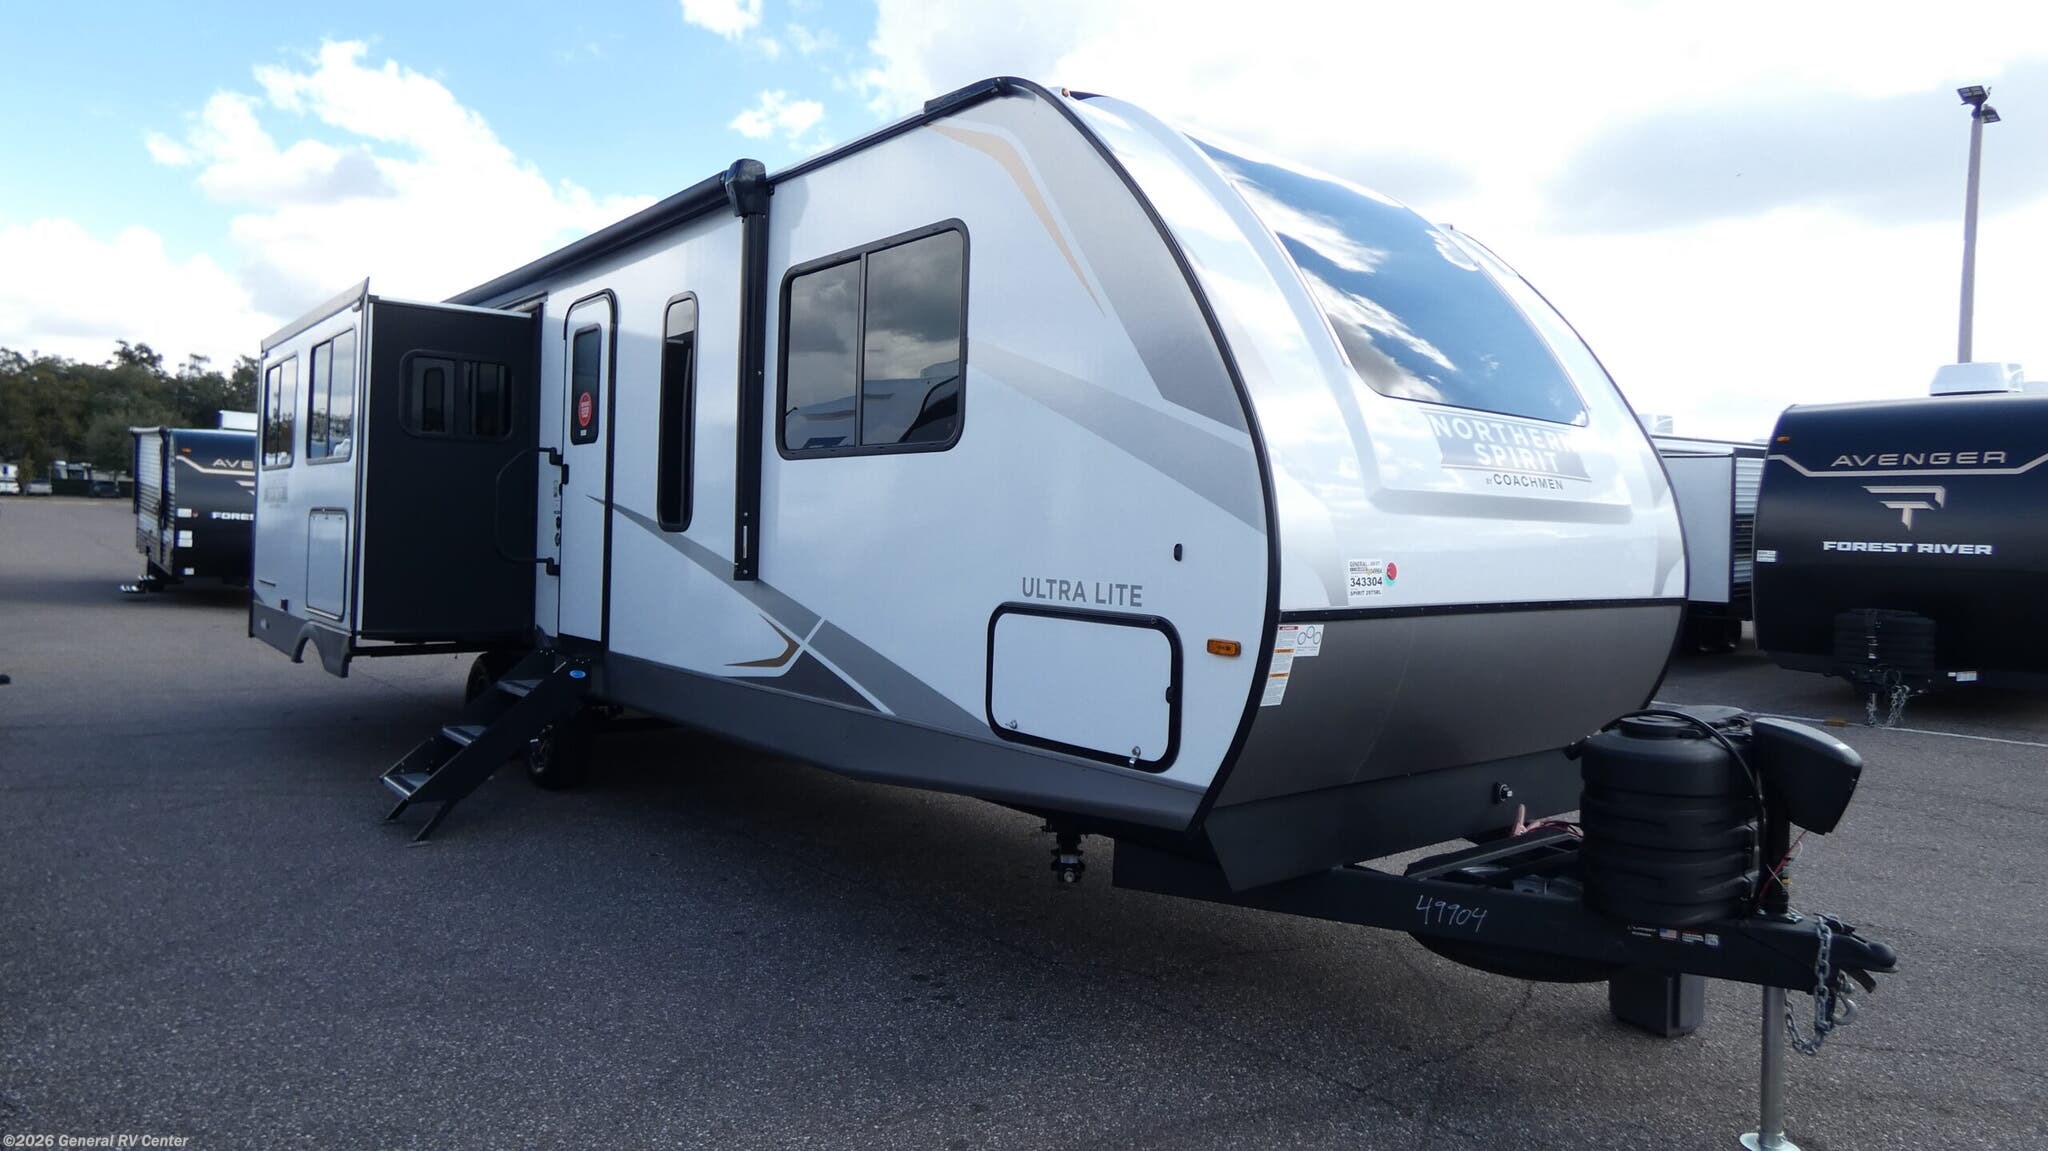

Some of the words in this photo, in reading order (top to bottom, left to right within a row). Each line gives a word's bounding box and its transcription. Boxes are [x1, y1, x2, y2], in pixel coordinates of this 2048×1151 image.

[1473, 443, 1559, 473] SPIRIT
[1830, 451, 2007, 468] AVENGER
[1493, 473, 1564, 491] COACHMEN
[1822, 540, 1913, 553] FOREST
[1916, 542, 1993, 555] RIVER
[1350, 577, 1383, 588] 343304
[1021, 577, 1087, 603] ULTRA
[1095, 582, 1143, 608] LITE
[1415, 894, 1488, 933] 49904
